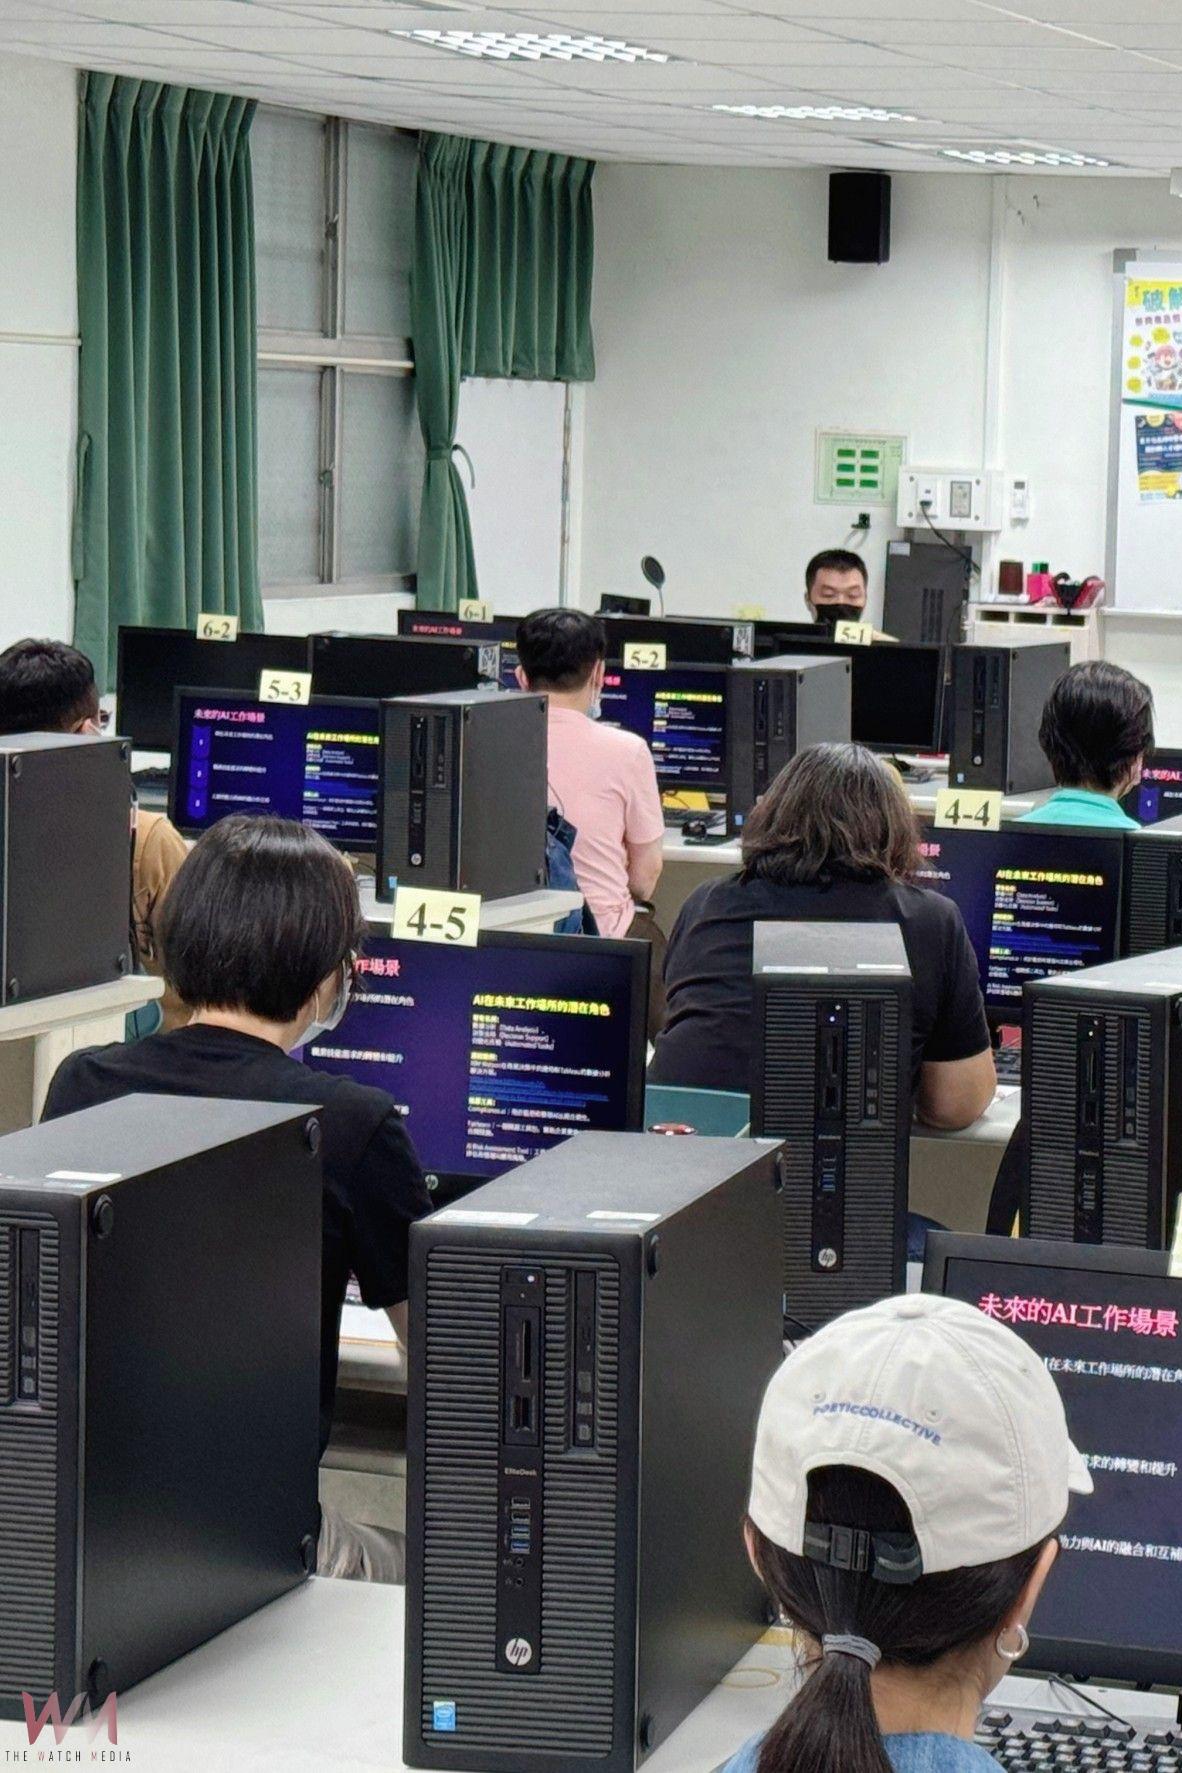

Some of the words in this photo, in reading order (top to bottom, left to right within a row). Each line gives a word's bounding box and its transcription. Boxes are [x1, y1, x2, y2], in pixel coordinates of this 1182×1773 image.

[463, 602, 487, 621] 6-1
[203, 622, 231, 639] 6-2
[841, 627, 865, 643] 5-1
[630, 650, 659, 668] 5-2
[267, 679, 302, 702] 5-3
[944, 798, 990, 827] 4-4
[406, 901, 469, 941] 4-5
[977, 1292, 1180, 1337] 未來的AI工作場景
